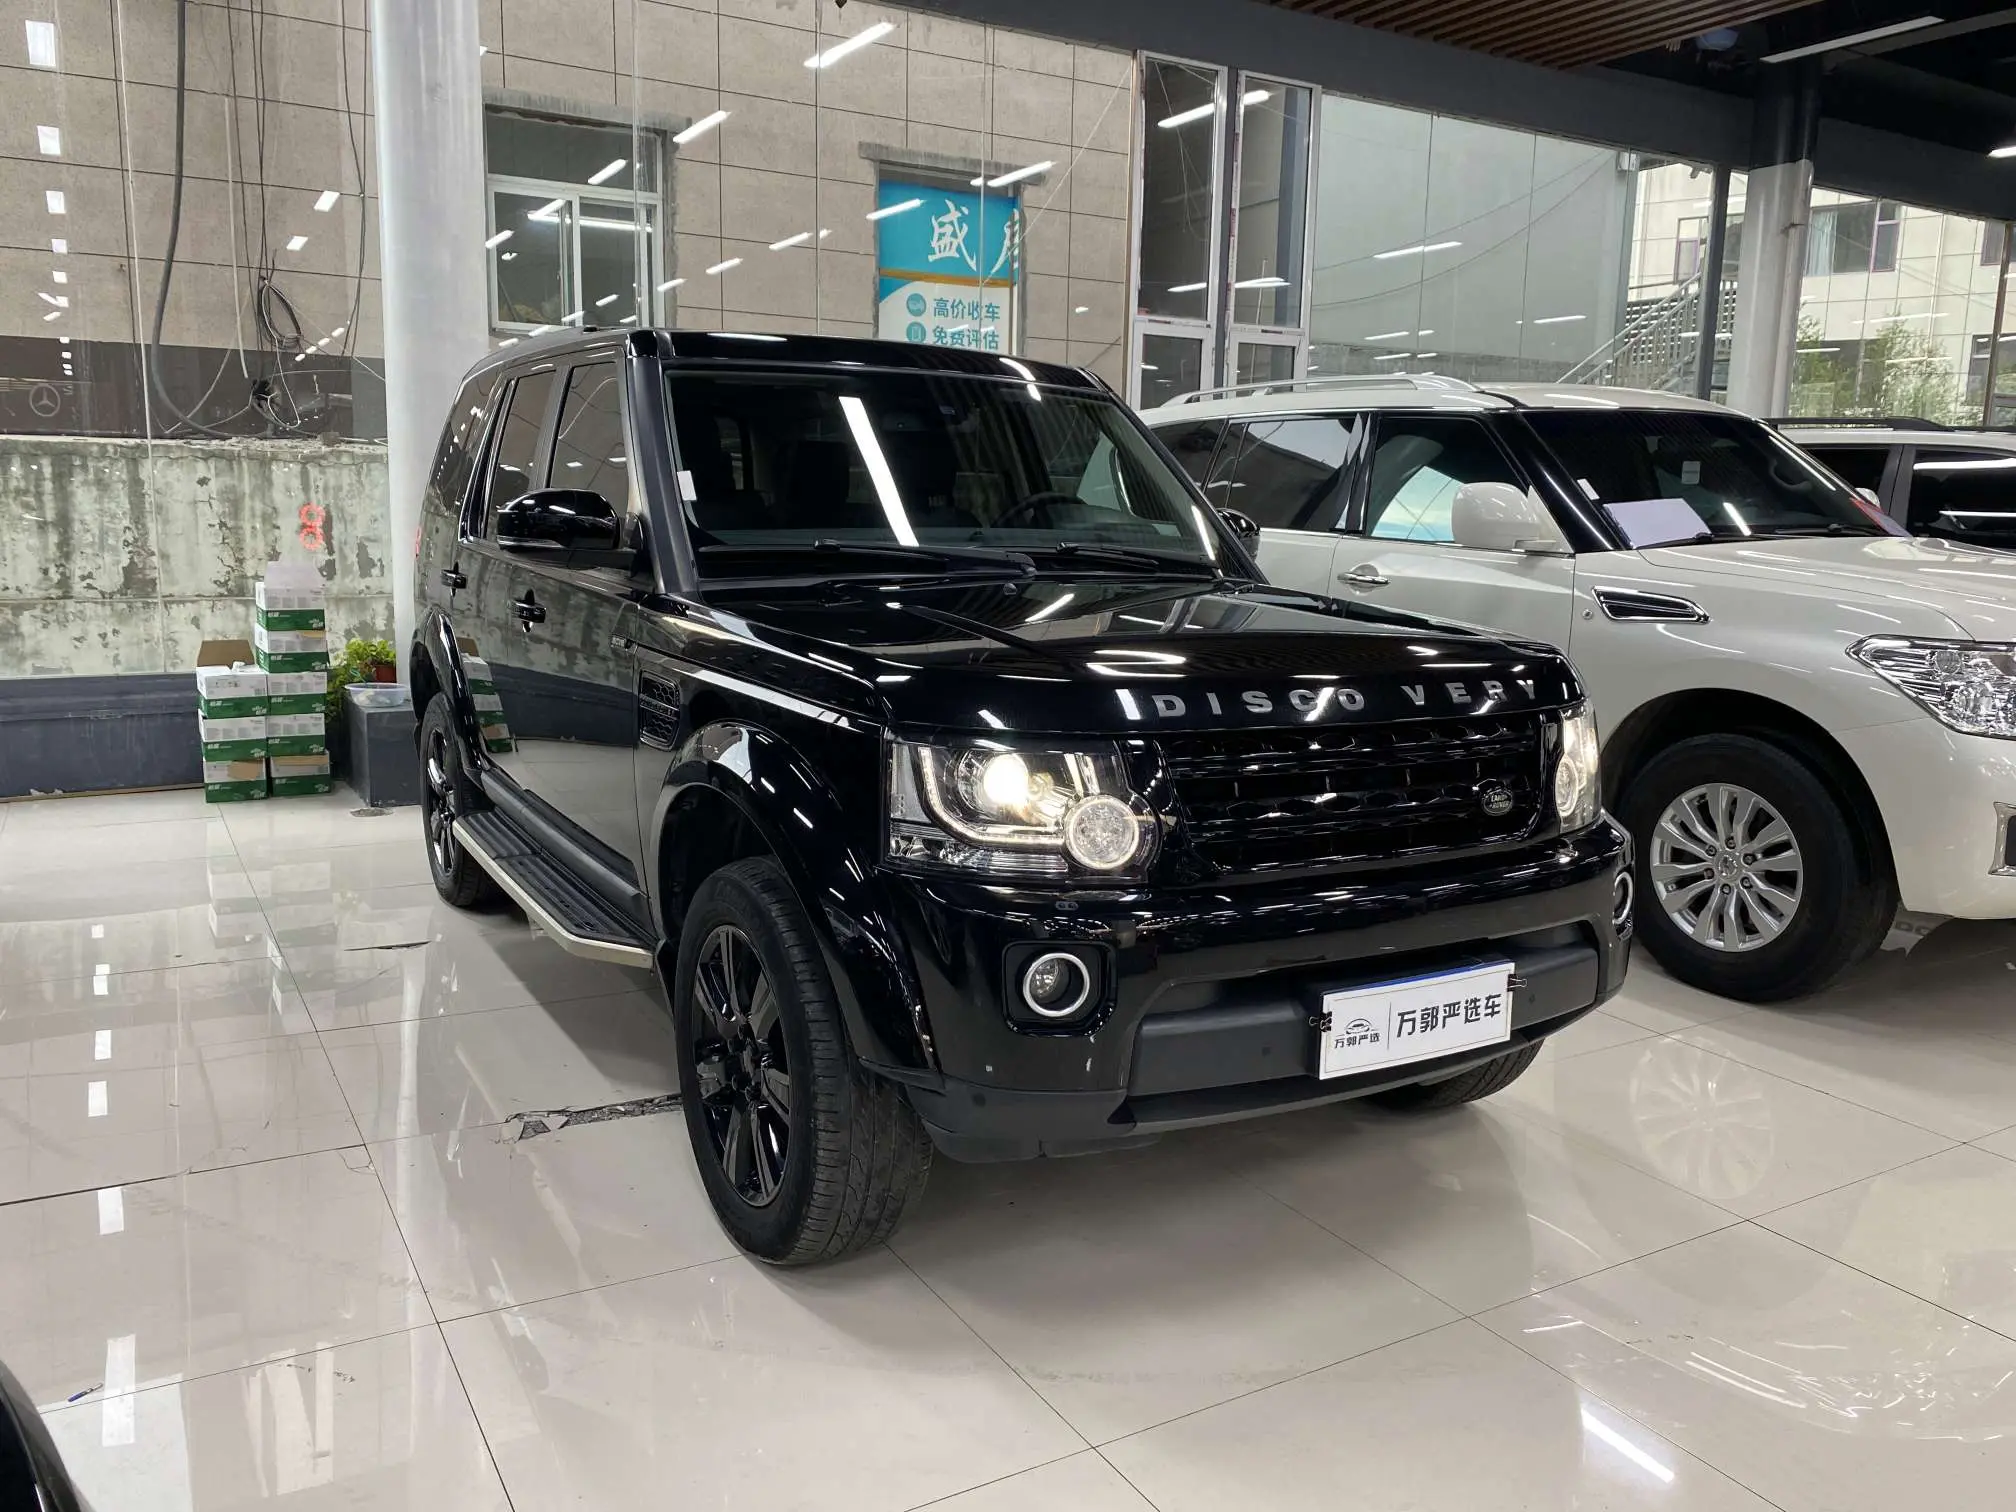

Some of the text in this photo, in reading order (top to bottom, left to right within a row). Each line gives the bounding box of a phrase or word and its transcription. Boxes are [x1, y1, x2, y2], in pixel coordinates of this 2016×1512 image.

[932, 297, 1001, 322] 高价收车
[932, 326, 999, 350] 免费评估
[1396, 993, 1502, 1038] 万郭严选车
[1334, 1032, 1381, 1049] 万郭严选
